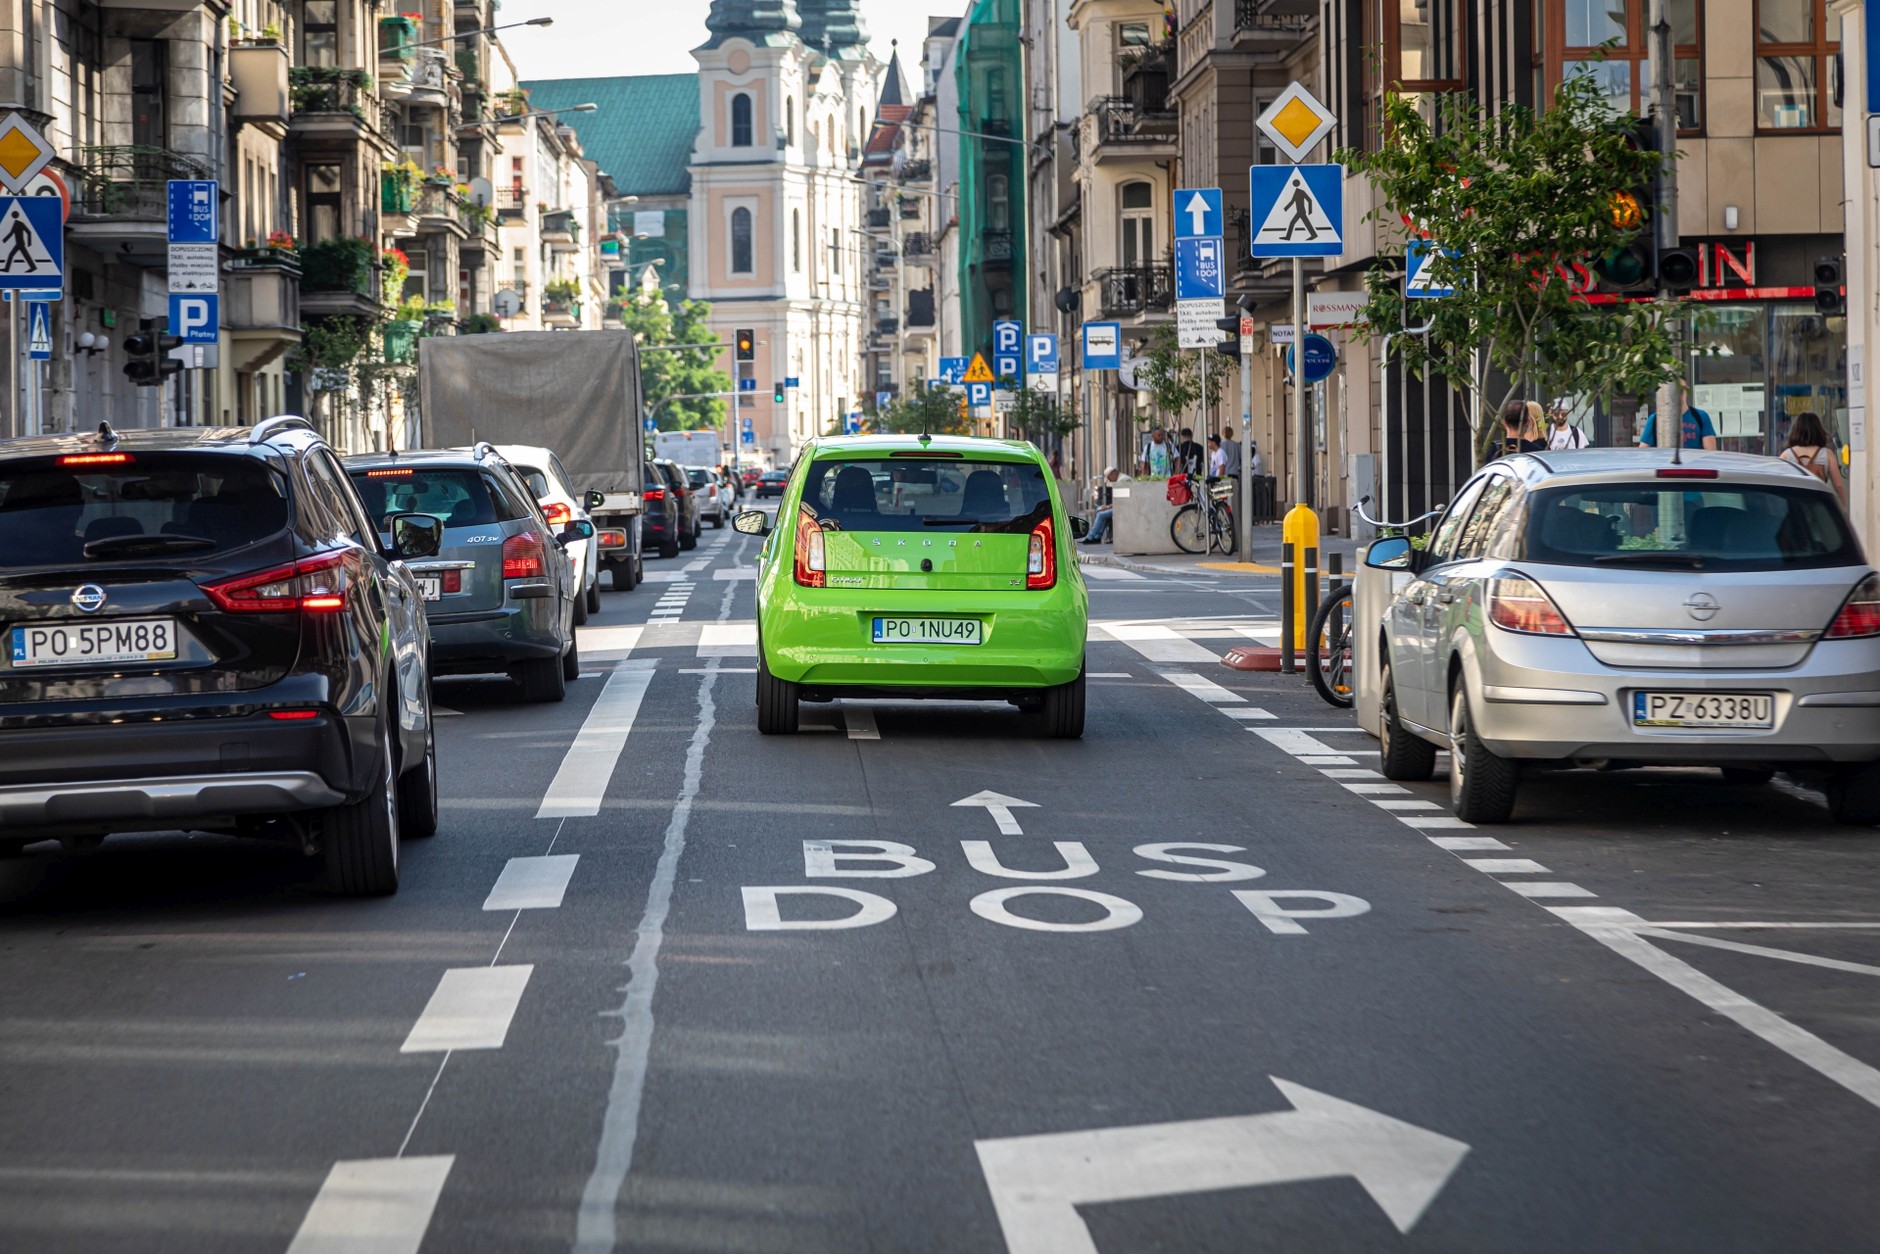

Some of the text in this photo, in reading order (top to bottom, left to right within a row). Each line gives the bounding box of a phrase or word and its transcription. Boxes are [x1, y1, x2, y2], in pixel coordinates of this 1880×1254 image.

[193, 204, 209, 213] BUS
[193, 213, 212, 221] DOP
[180, 299, 208, 337] P
[1001, 329, 1017, 352] P
[1033, 337, 1052, 363] P
[972, 384, 987, 404] P
[466, 535, 486, 543] 407
[31, 624, 167, 657] PO 5PM88
[886, 620, 975, 639] PO 1NU49
[14, 648, 24, 656] PL
[1651, 696, 1769, 721] PZ 6338U
[803, 839, 1267, 883] BUS
[740, 885, 1372, 936] DOP
